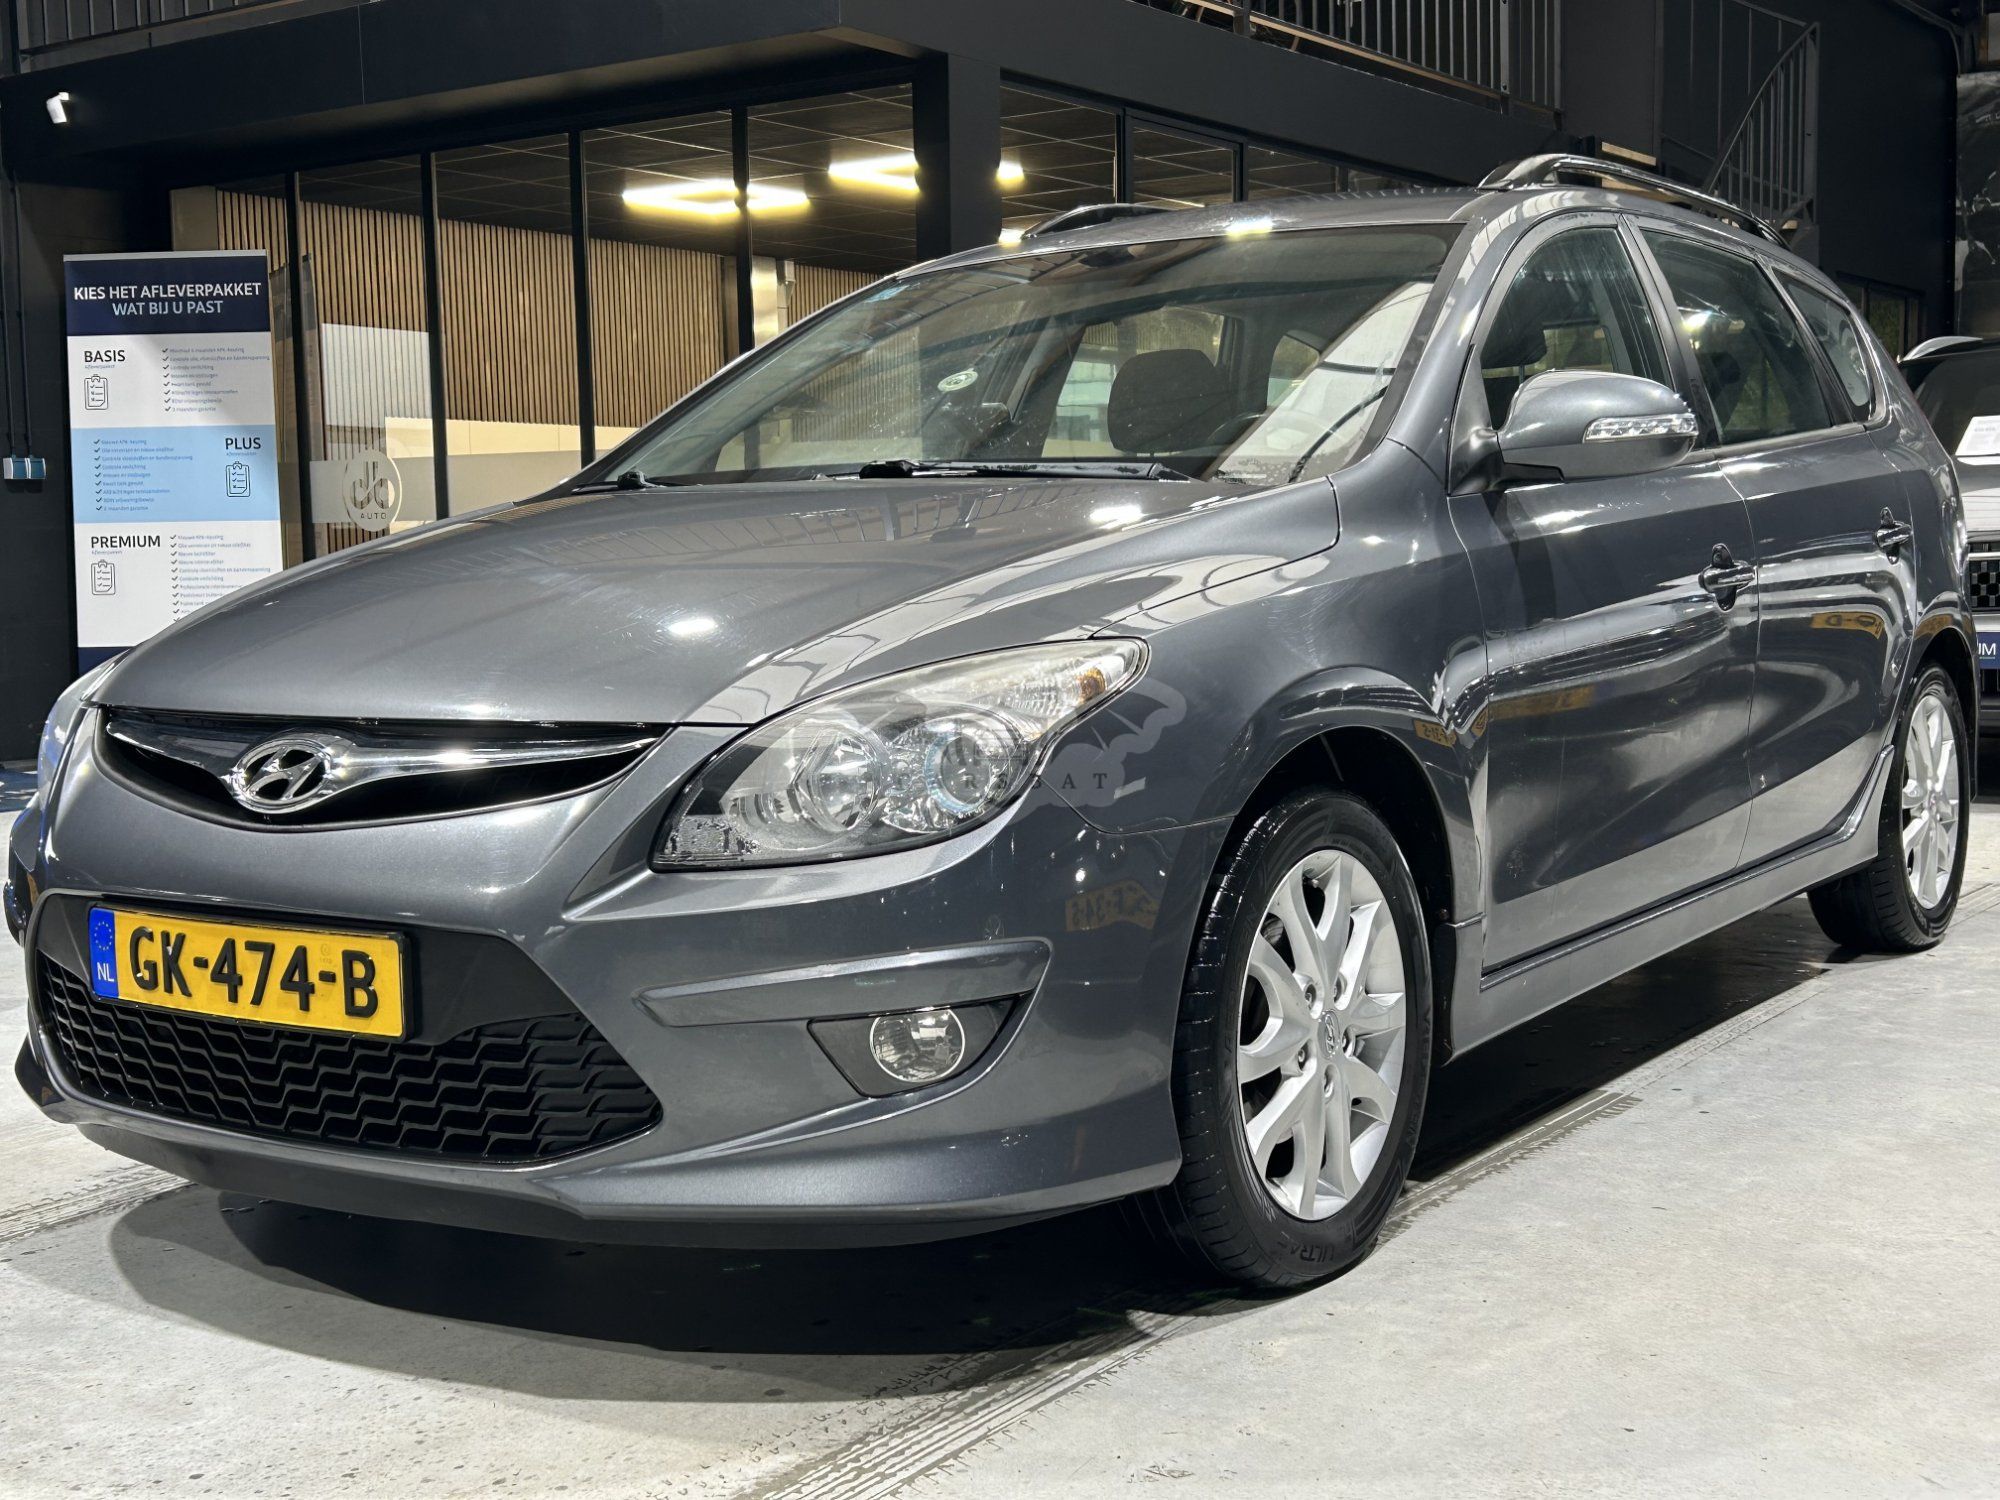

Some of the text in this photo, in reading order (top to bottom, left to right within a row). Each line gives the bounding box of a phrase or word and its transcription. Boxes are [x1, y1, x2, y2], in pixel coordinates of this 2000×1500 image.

[73, 282, 262, 301] KIES HET AFLEVERPAKKET
[112, 300, 224, 316] WAT BIJ U PAST
[84, 349, 126, 363] BASIS
[225, 437, 262, 450] PLUS
[360, 512, 388, 520] AUTO
[90, 535, 161, 549] PREMIUM
[96, 961, 115, 983] NL
[129, 926, 379, 1019] GK-474-B
